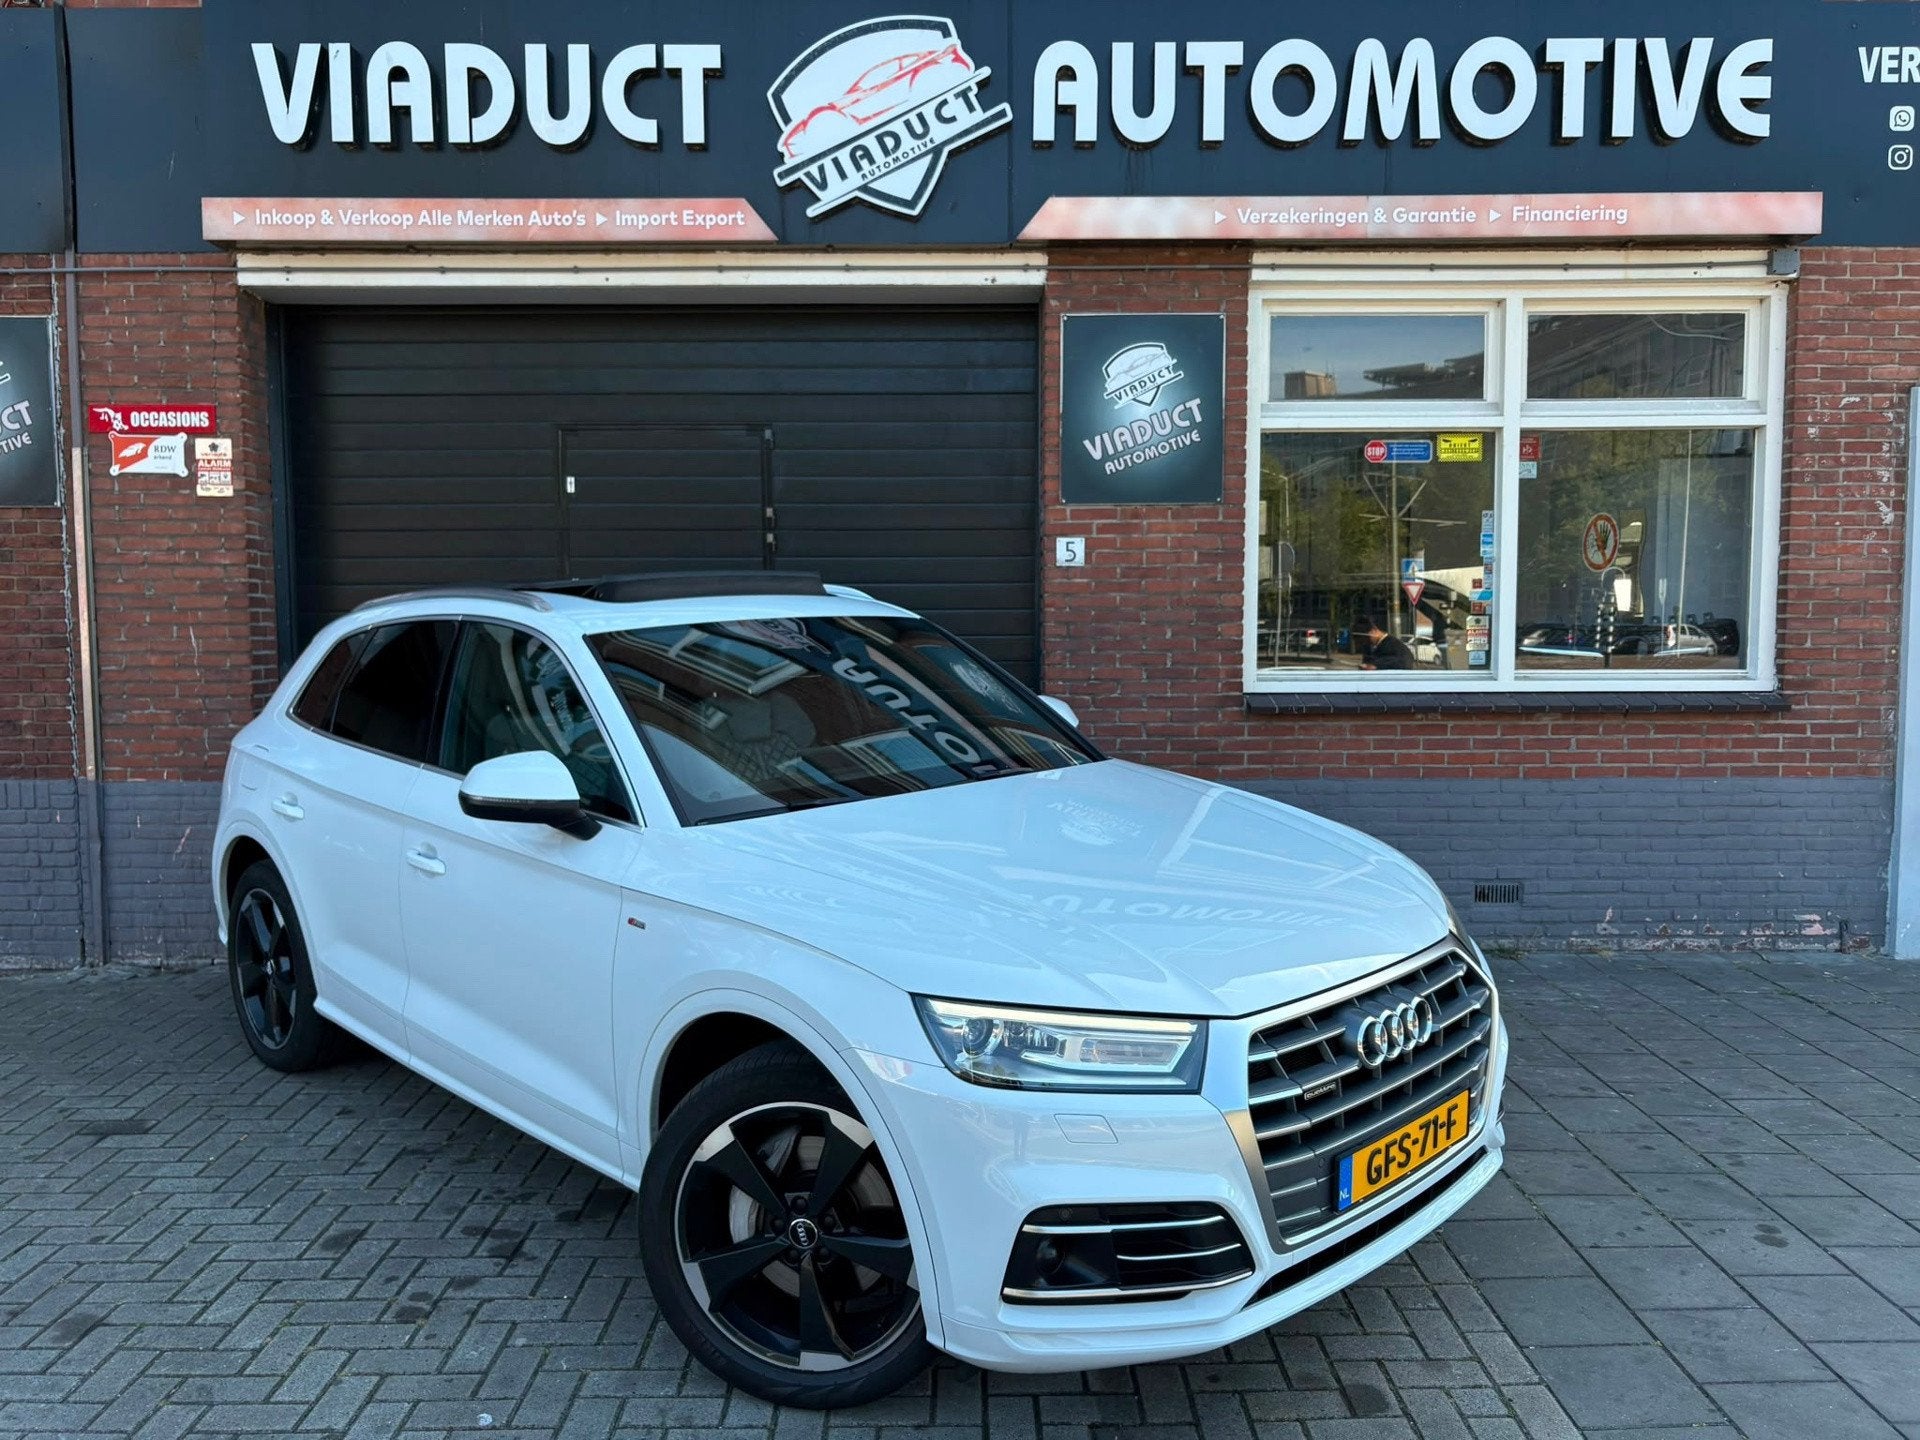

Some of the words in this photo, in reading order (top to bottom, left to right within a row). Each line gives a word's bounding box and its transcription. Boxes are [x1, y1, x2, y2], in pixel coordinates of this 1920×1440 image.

[1858, 46, 1920, 83] VER
[251, 41, 722, 145] VIADUCT
[1032, 36, 1774, 144] AUTOMOTIVE
[803, 85, 978, 192] VIADUCT
[860, 137, 936, 182] AUTOMOTIVE
[255, 209, 316, 229] Inkoop
[320, 209, 335, 226] &
[338, 209, 414, 229] Verkoop
[418, 209, 453, 226] Alle
[457, 209, 524, 226] Merken
[528, 209, 586, 226] Auto's
[615, 210, 678, 229] Import
[682, 210, 746, 229] Export
[1237, 206, 1369, 228] Verzekeringen
[1373, 206, 1388, 224] &
[1392, 206, 1477, 224] Garantie
[1512, 205, 1629, 225] Financiering
[1115, 365, 1172, 401] VIADUCT
[0, 400, 33, 432] CT
[129, 411, 210, 428] OCCASIONS
[1082, 397, 1203, 461] VIADUCT
[0, 432, 32, 454] TIVE
[153, 444, 177, 453] RDW
[1104, 429, 1202, 475] AUTOMOTIVE
[1366, 446, 1385, 457] STOP
[197, 459, 232, 467] ALARM
[1064, 541, 1077, 563] 5
[1366, 1102, 1459, 1187] GFS-71-F
[1339, 1188, 1350, 1200] NL
